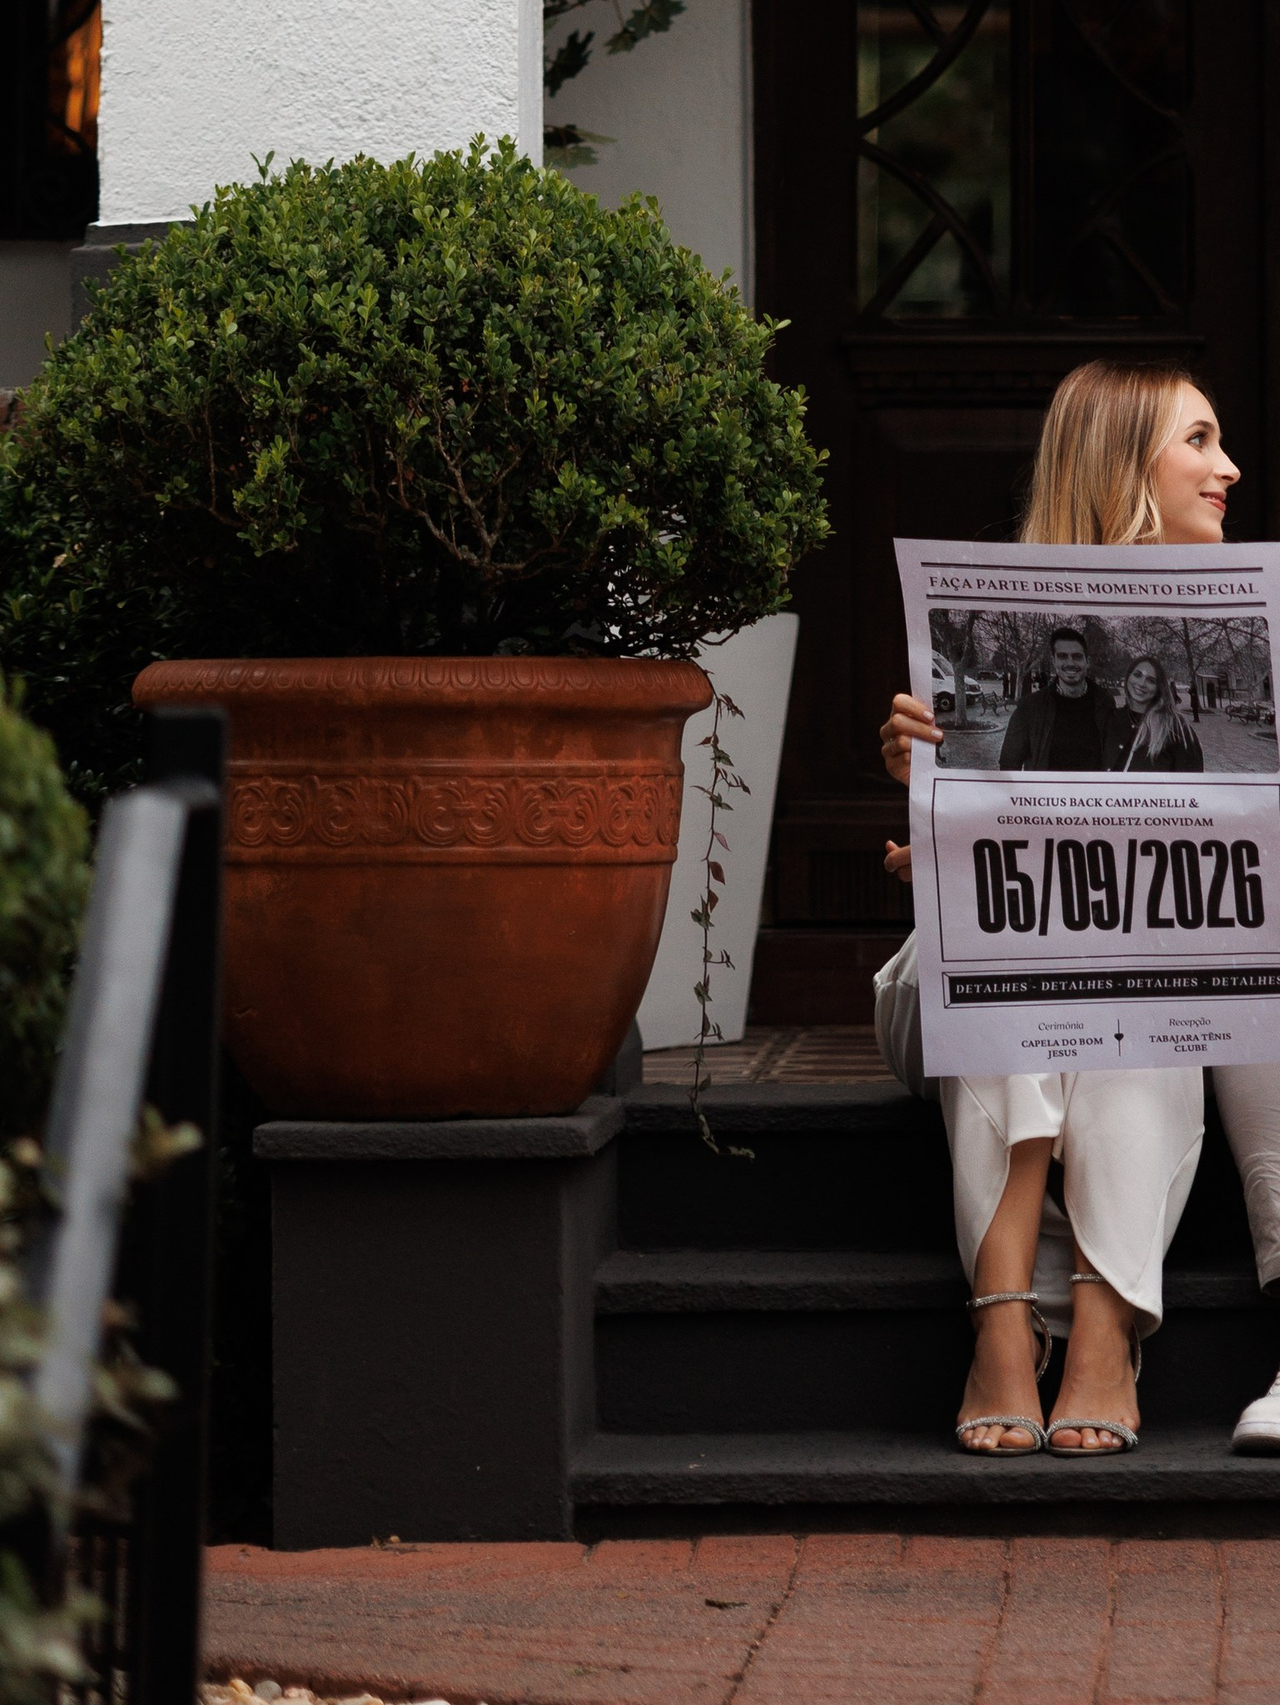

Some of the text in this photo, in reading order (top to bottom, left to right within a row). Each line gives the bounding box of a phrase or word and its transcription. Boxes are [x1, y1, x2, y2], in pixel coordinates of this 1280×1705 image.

[929, 576, 1259, 596] FAÇA PARTE DESSE MOMENTO ESPECIAL
[1010, 796, 1200, 809] VINICIUS BACK CAMPANELLI &
[997, 814, 1214, 827] GEORGIA ROZA HOLETZ CONVIDAM
[972, 838, 1266, 936] 05/09/2026
[956, 980, 1028, 995] DETALHES
[1041, 978, 1114, 992] DETALHES
[1126, 976, 1199, 990] DETALHES
[1038, 1021, 1084, 1031] Cerimônia
[1169, 1017, 1211, 1029] Recepção
[1021, 1037, 1104, 1048] CAPELA DO BOM
[1149, 1032, 1232, 1045] TABAJARA TÊNIS
[1047, 1049, 1078, 1059] JESUS
[1174, 1044, 1208, 1053] CLUBE
